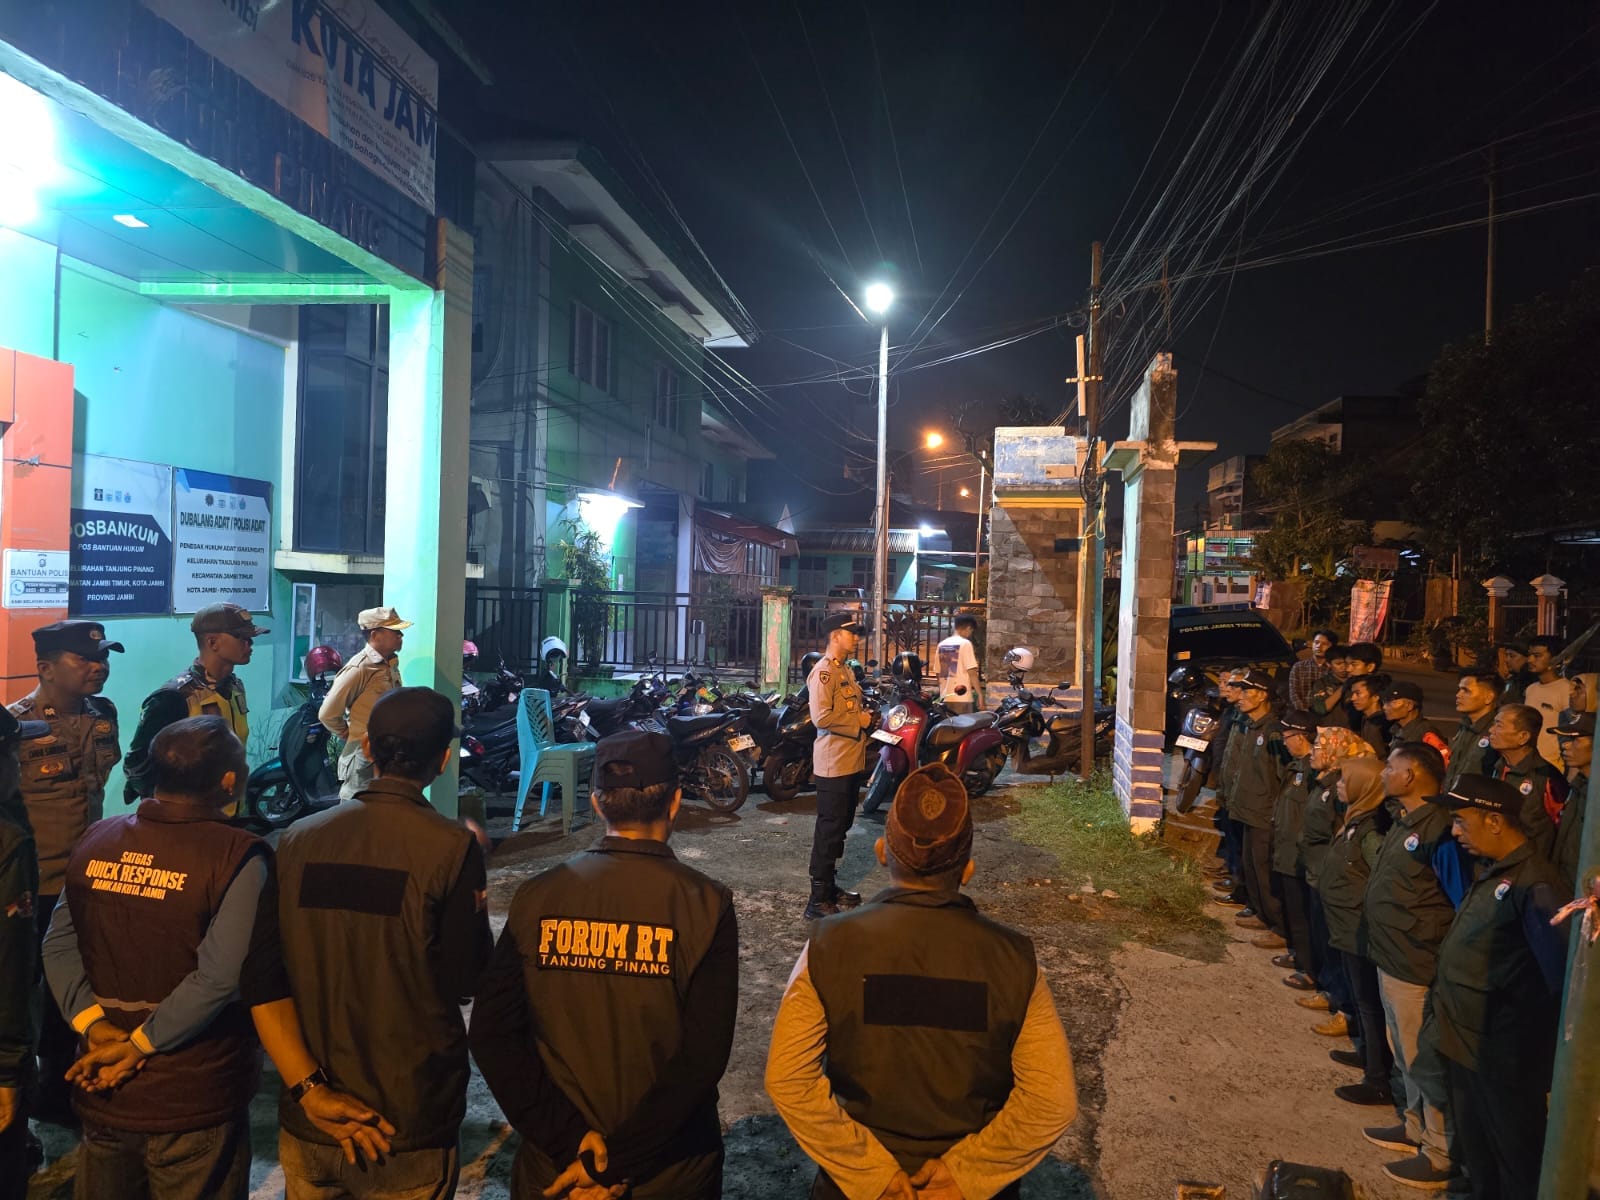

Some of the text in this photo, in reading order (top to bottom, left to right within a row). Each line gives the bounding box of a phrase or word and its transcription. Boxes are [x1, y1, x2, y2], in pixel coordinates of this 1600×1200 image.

[180, 511, 213, 528] DUBALANG
[214, 515, 230, 529] ADAT
[251, 518, 266, 532] ADAT
[70, 520, 160, 546] OSBANKUM
[92, 544, 122, 552] BANTUAN
[123, 545, 145, 553] HUKUM
[10, 569, 47, 577] BANTUAN
[105, 565, 132, 573] TANJUNG
[92, 579, 111, 587] JAMBI
[132, 579, 147, 587] KOTA
[87, 593, 135, 601] PROVINSI JAMBI
[1179, 625, 1210, 633] POLSEK
[120, 851, 155, 866] SATGAS
[85, 859, 189, 891] QUICK RESPONSE
[121, 883, 140, 896] KOTA
[140, 886, 167, 900] JAMBI
[538, 919, 674, 963] FORUM RT
[540, 954, 671, 975] TANJUNG PINANG
